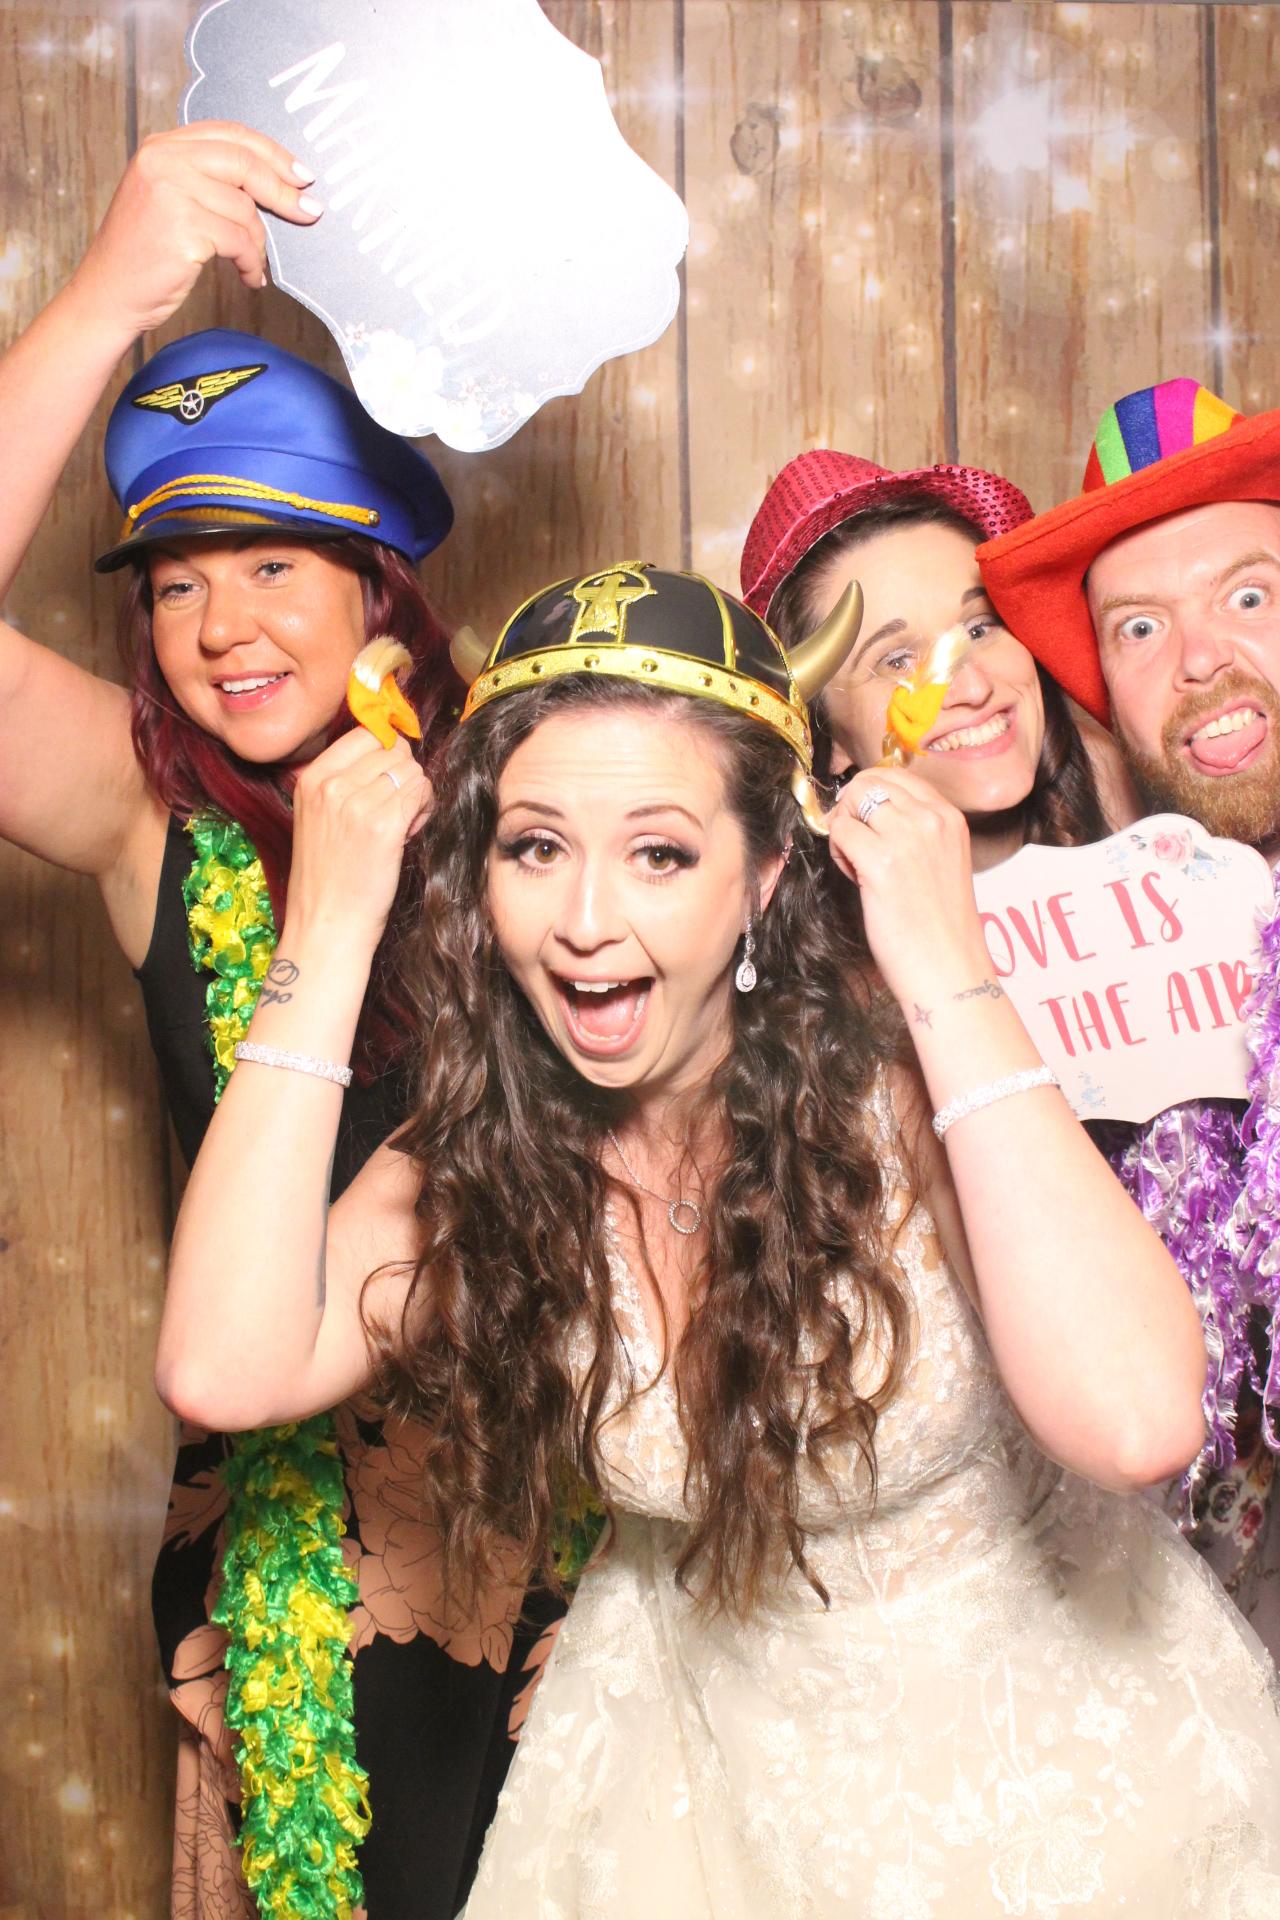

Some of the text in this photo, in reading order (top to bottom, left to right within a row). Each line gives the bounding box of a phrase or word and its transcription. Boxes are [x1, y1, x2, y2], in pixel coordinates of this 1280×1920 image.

[978, 871, 1184, 978] OVE IS
[1038, 982, 1147, 1057] THE
